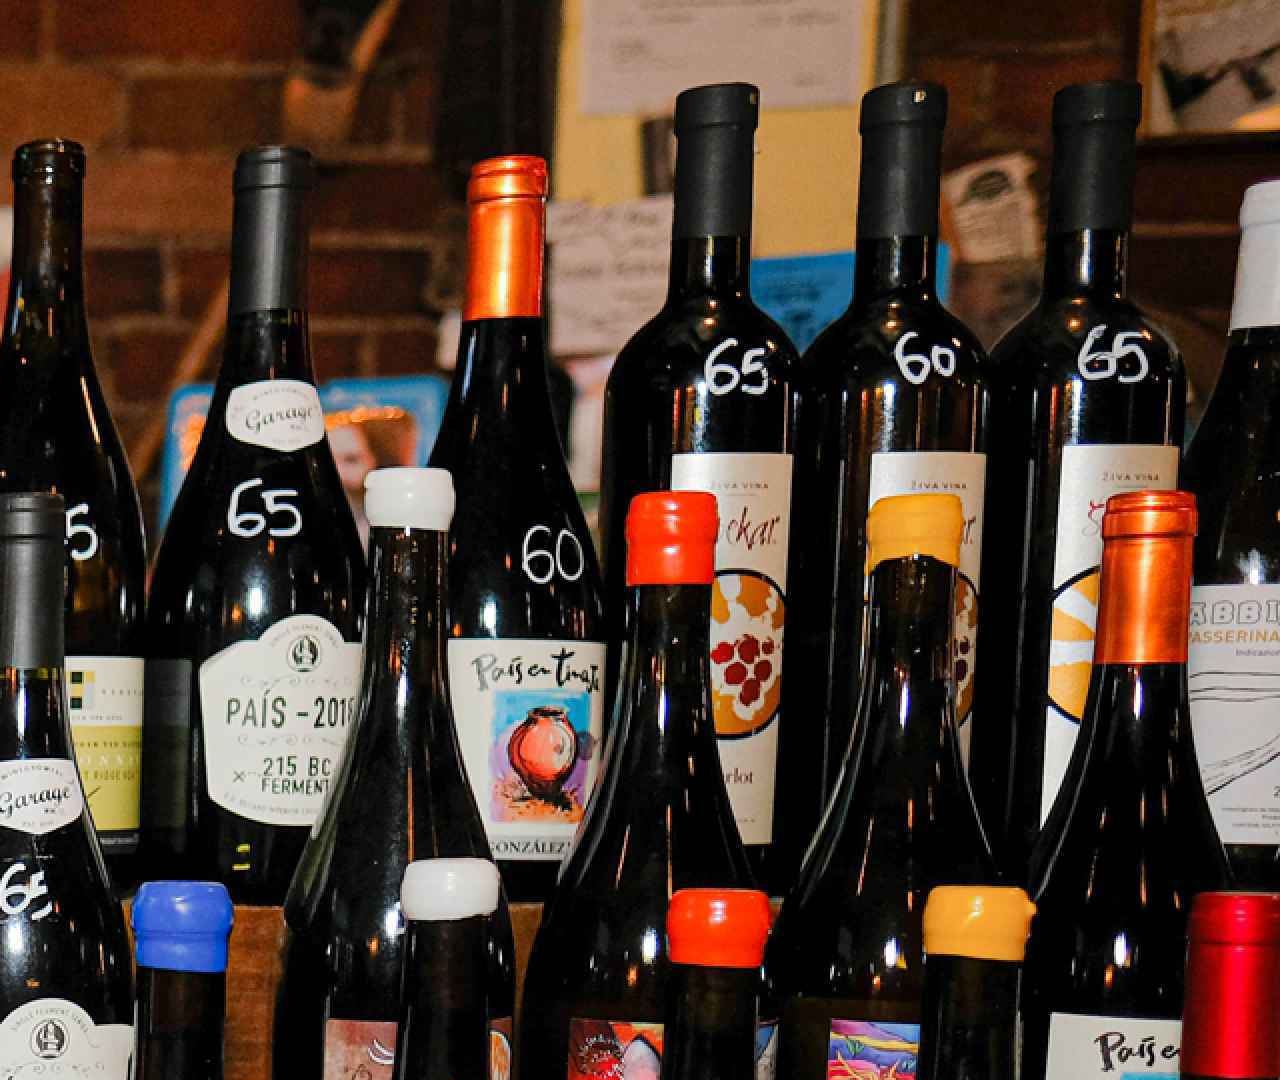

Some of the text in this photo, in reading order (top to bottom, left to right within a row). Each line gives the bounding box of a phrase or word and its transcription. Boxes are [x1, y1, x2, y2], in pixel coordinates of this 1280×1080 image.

[704, 337, 770, 396] 65
[894, 331, 957, 384] 60
[1078, 323, 1151, 383] 65
[64, 503, 98, 561] 5
[227, 478, 303, 538] 65
[521, 524, 585, 584] 60
[225, 689, 287, 729] PAÍS
[261, 777, 330, 795] FERMENT
[263, 755, 331, 777] 215 BC
[726, 767, 753, 785] rlot
